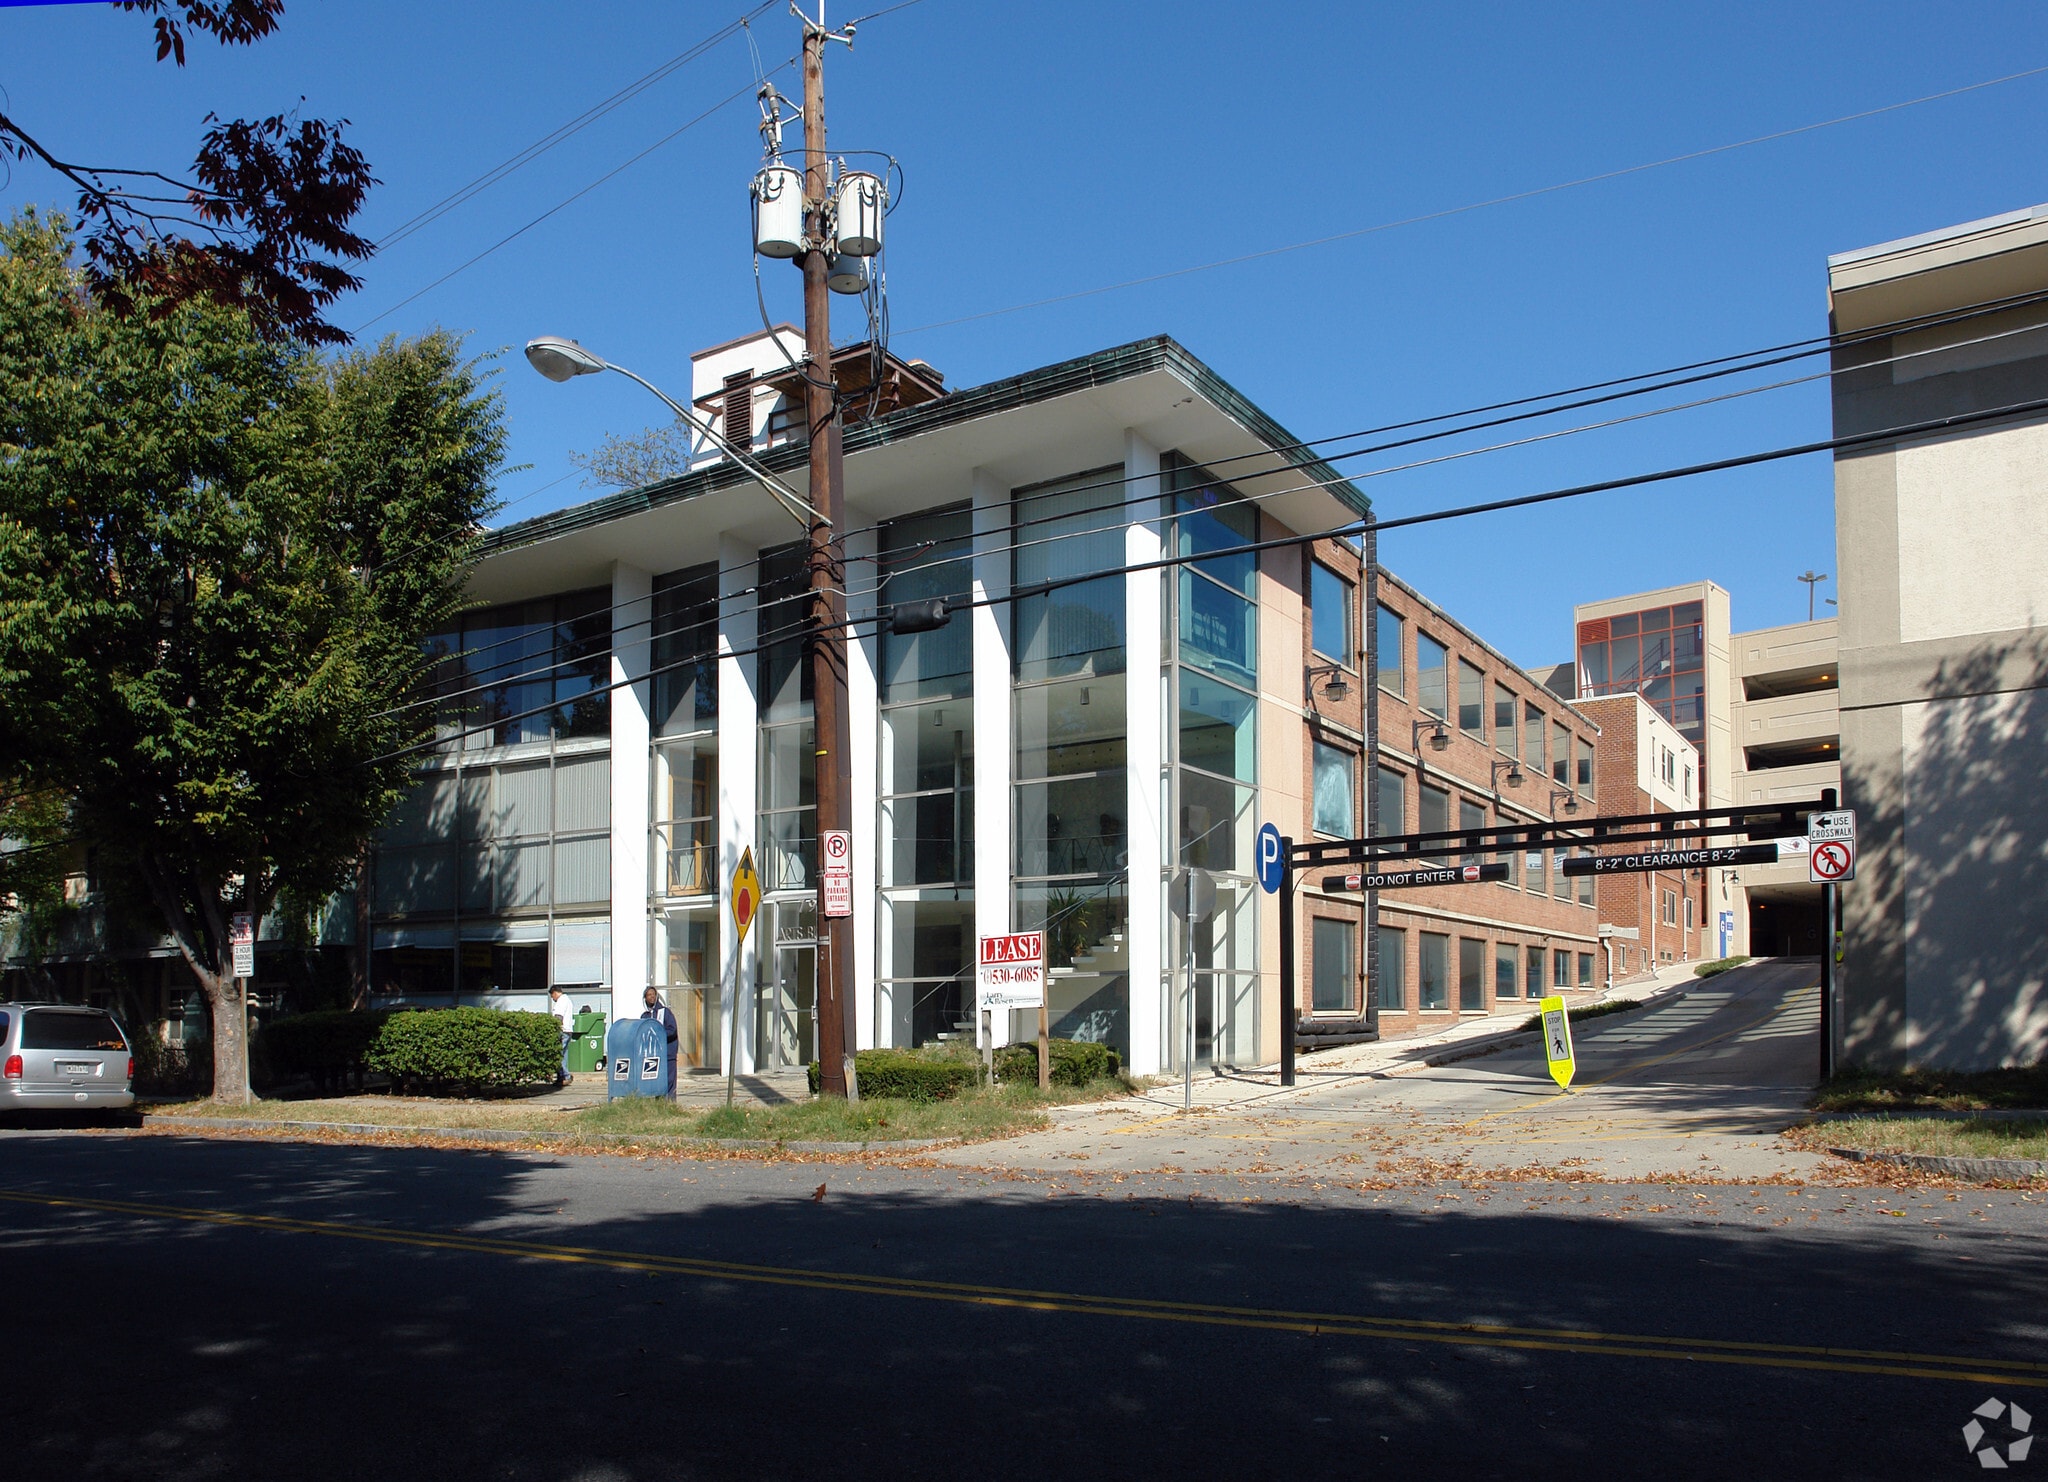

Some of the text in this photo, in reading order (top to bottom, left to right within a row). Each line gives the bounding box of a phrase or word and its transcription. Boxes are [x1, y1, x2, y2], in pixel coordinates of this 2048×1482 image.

[1833, 816, 1849, 826] USE
[1811, 827, 1852, 839] CROSSWALK
[1262, 832, 1278, 882] P
[1595, 849, 1741, 870] 8'-2" CLEARANCE 8'-2"
[833, 879, 841, 887] NO
[1367, 870, 1456, 887] DO NOT ENTER
[827, 887, 848, 895] PARKING
[827, 894, 848, 902] ENTRANCE
[1720, 920, 1726, 933] G
[981, 935, 1041, 962] LEASE
[1547, 1016, 1561, 1025] STOP
